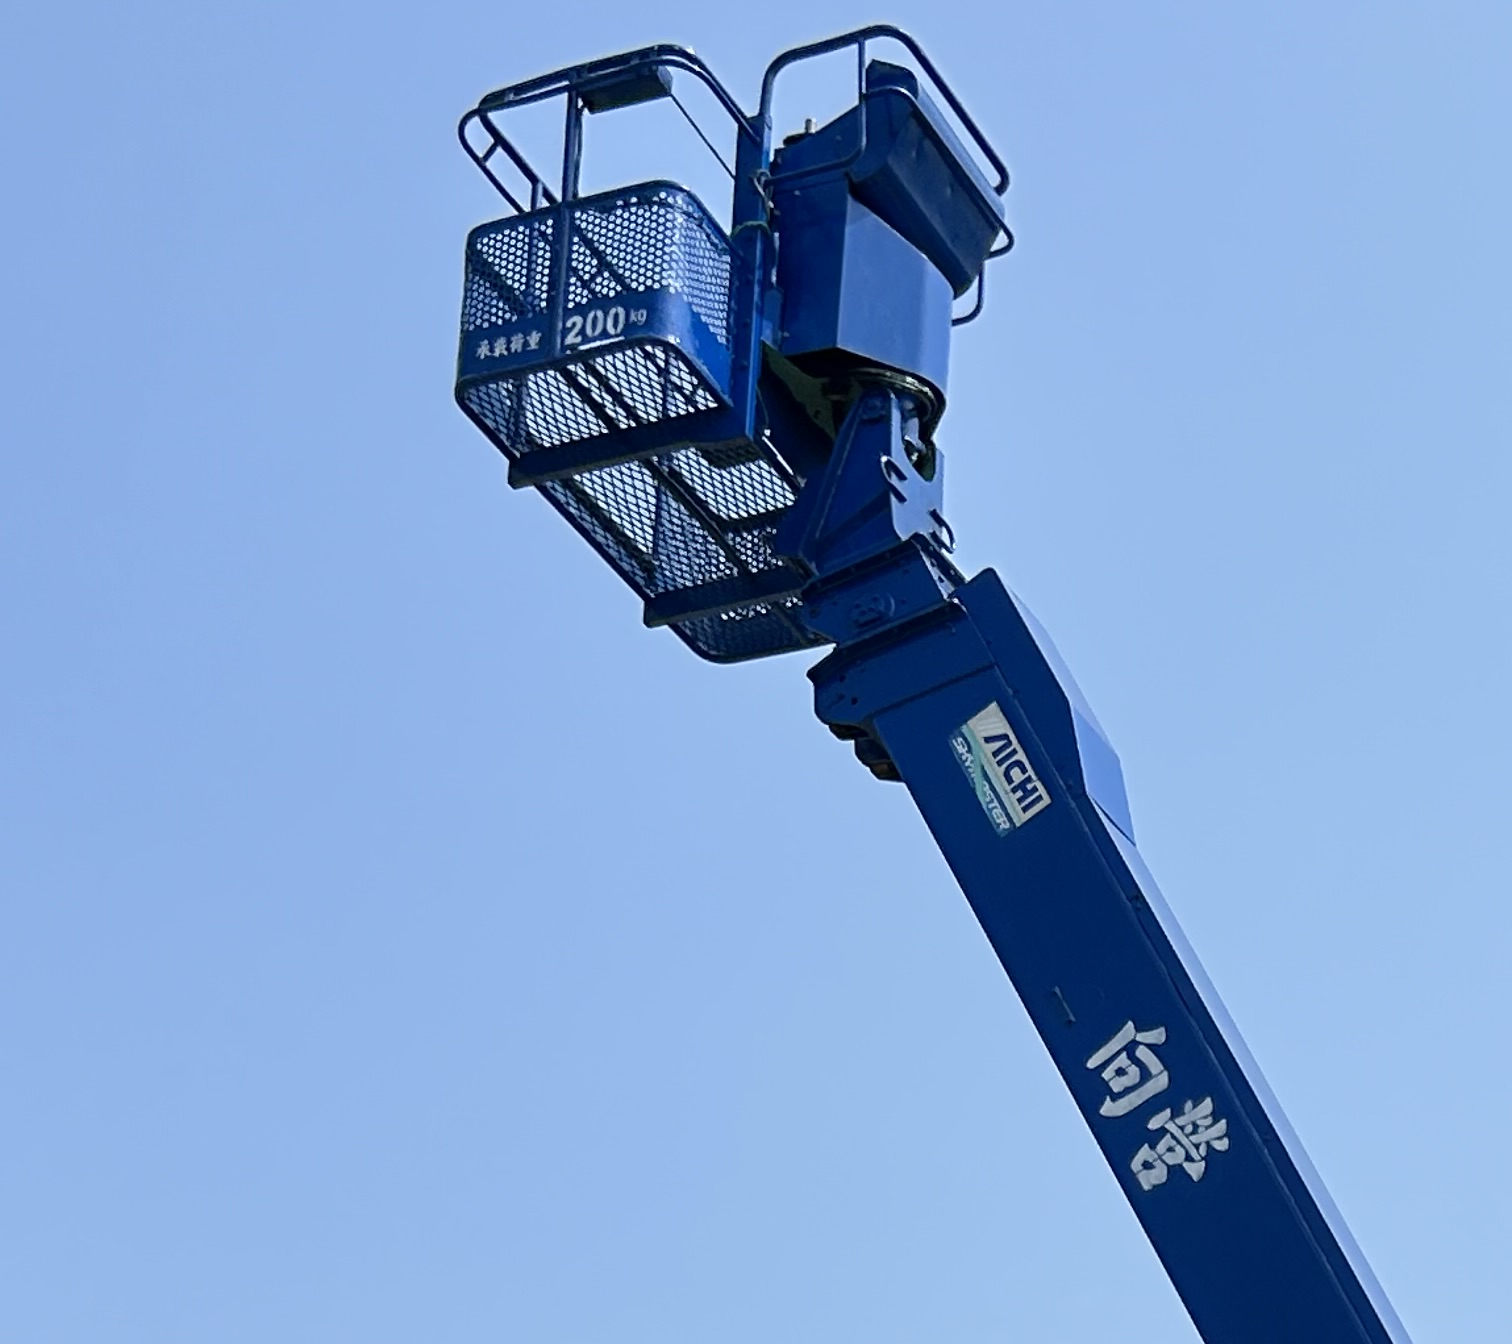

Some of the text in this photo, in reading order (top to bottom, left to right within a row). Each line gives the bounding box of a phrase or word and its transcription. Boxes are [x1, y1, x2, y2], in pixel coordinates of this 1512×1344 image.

[564, 306, 626, 345] 200
[629, 308, 647, 325] kg
[983, 733, 1043, 814] AICHI
